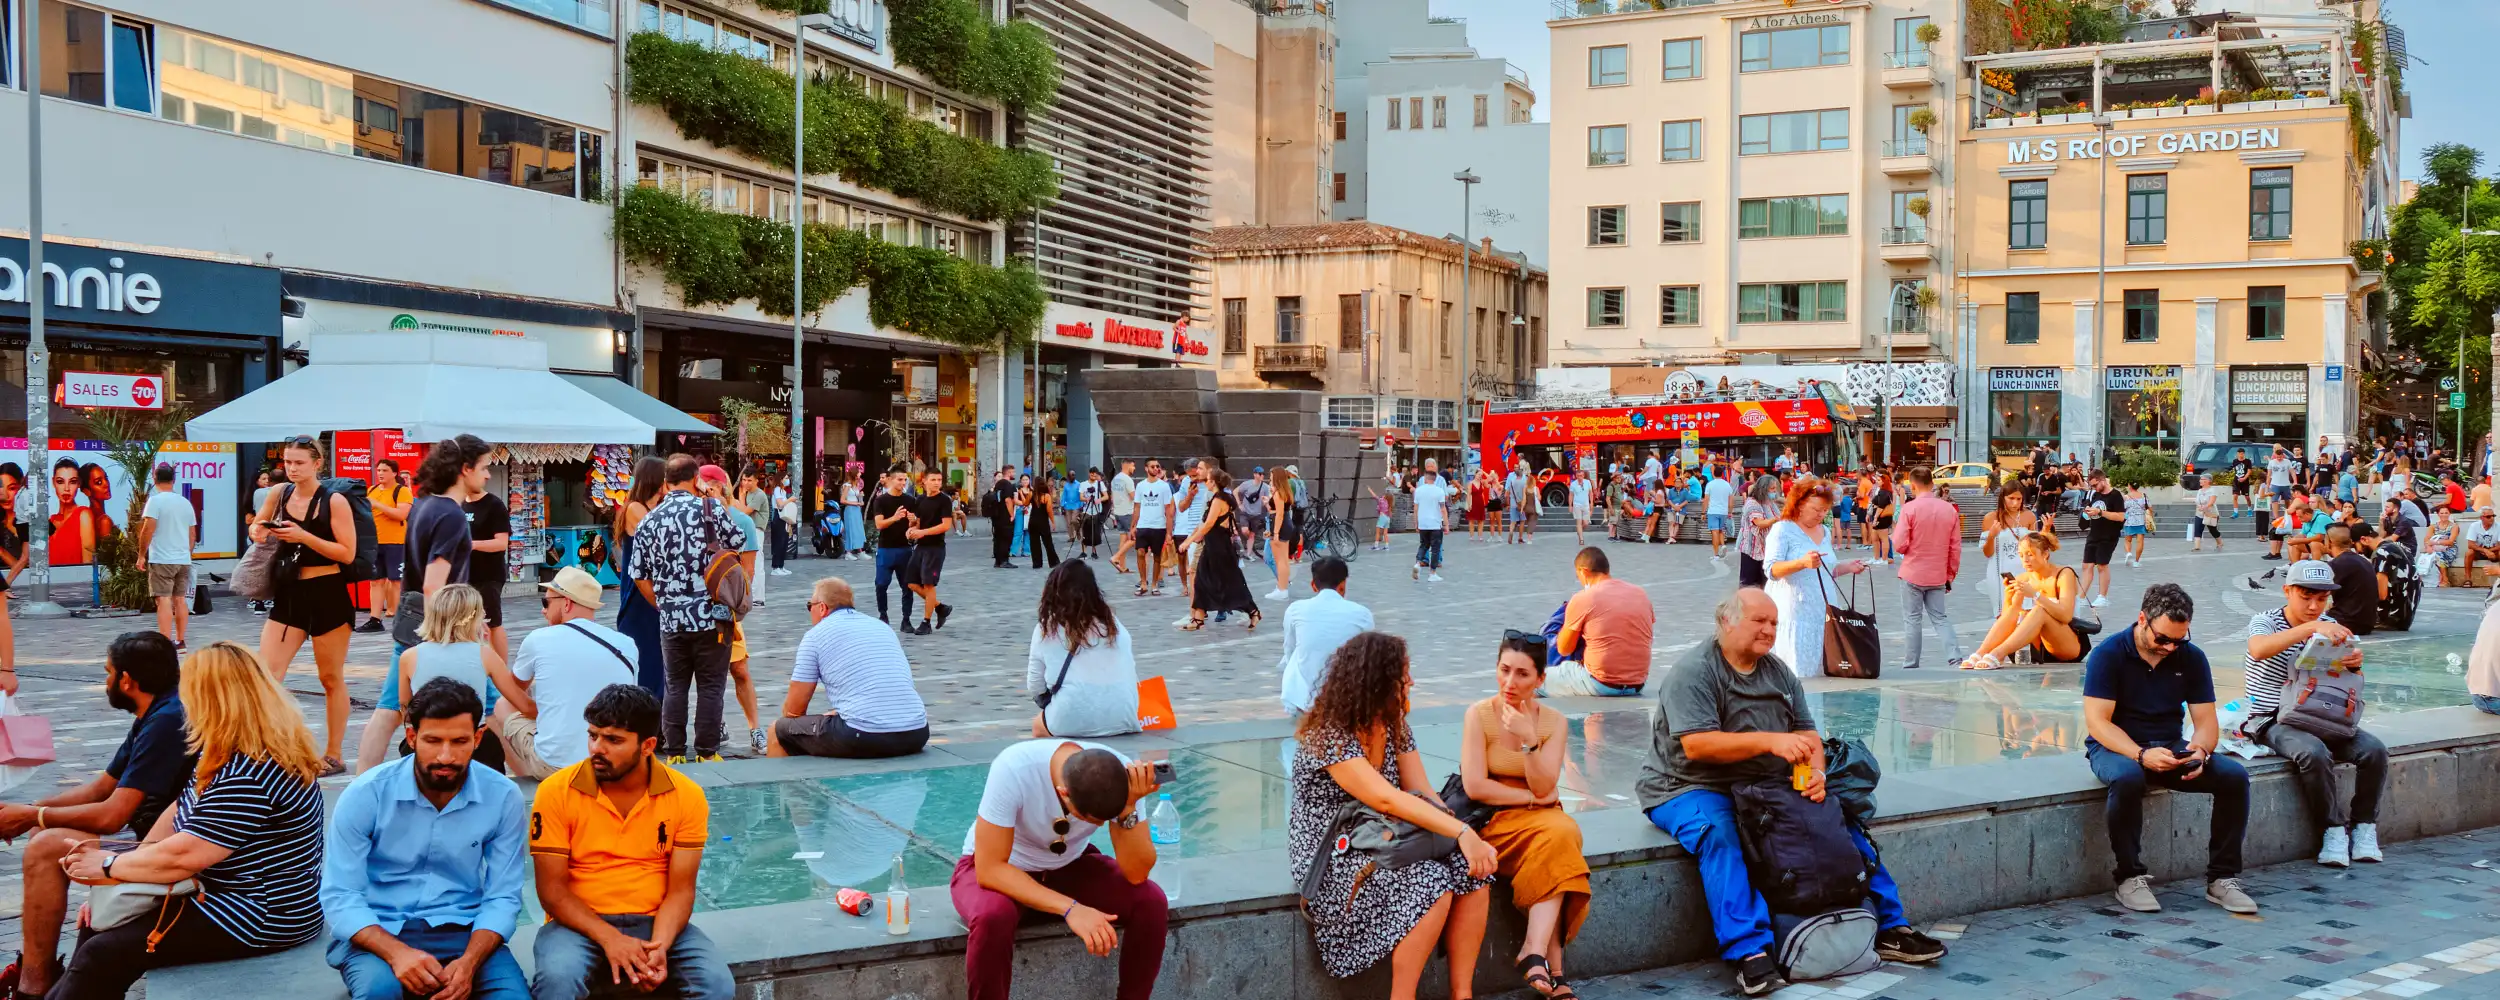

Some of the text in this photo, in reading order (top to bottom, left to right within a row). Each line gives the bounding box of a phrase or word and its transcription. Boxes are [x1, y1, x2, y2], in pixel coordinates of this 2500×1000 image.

[1750, 17, 1761, 29] A
[1766, 16, 1785, 28] for
[2068, 135, 2147, 160] ROOF
[2157, 127, 2280, 155] GARDEN
[1995, 369, 2055, 378] BRUNCH
[2238, 371, 2303, 381] BRUNCH
[72, 383, 119, 397] SALES
[940, 384, 954, 396] LEGO
[1992, 380, 2059, 390] LUNCH-DINNER
[2234, 382, 2307, 392] LUNCH-DINNER
[2233, 393, 2307, 403] GREEK CUISINE
[59, 441, 75, 449] TO
[83, 441, 106, 449] THE
[531, 811, 543, 841] 3
